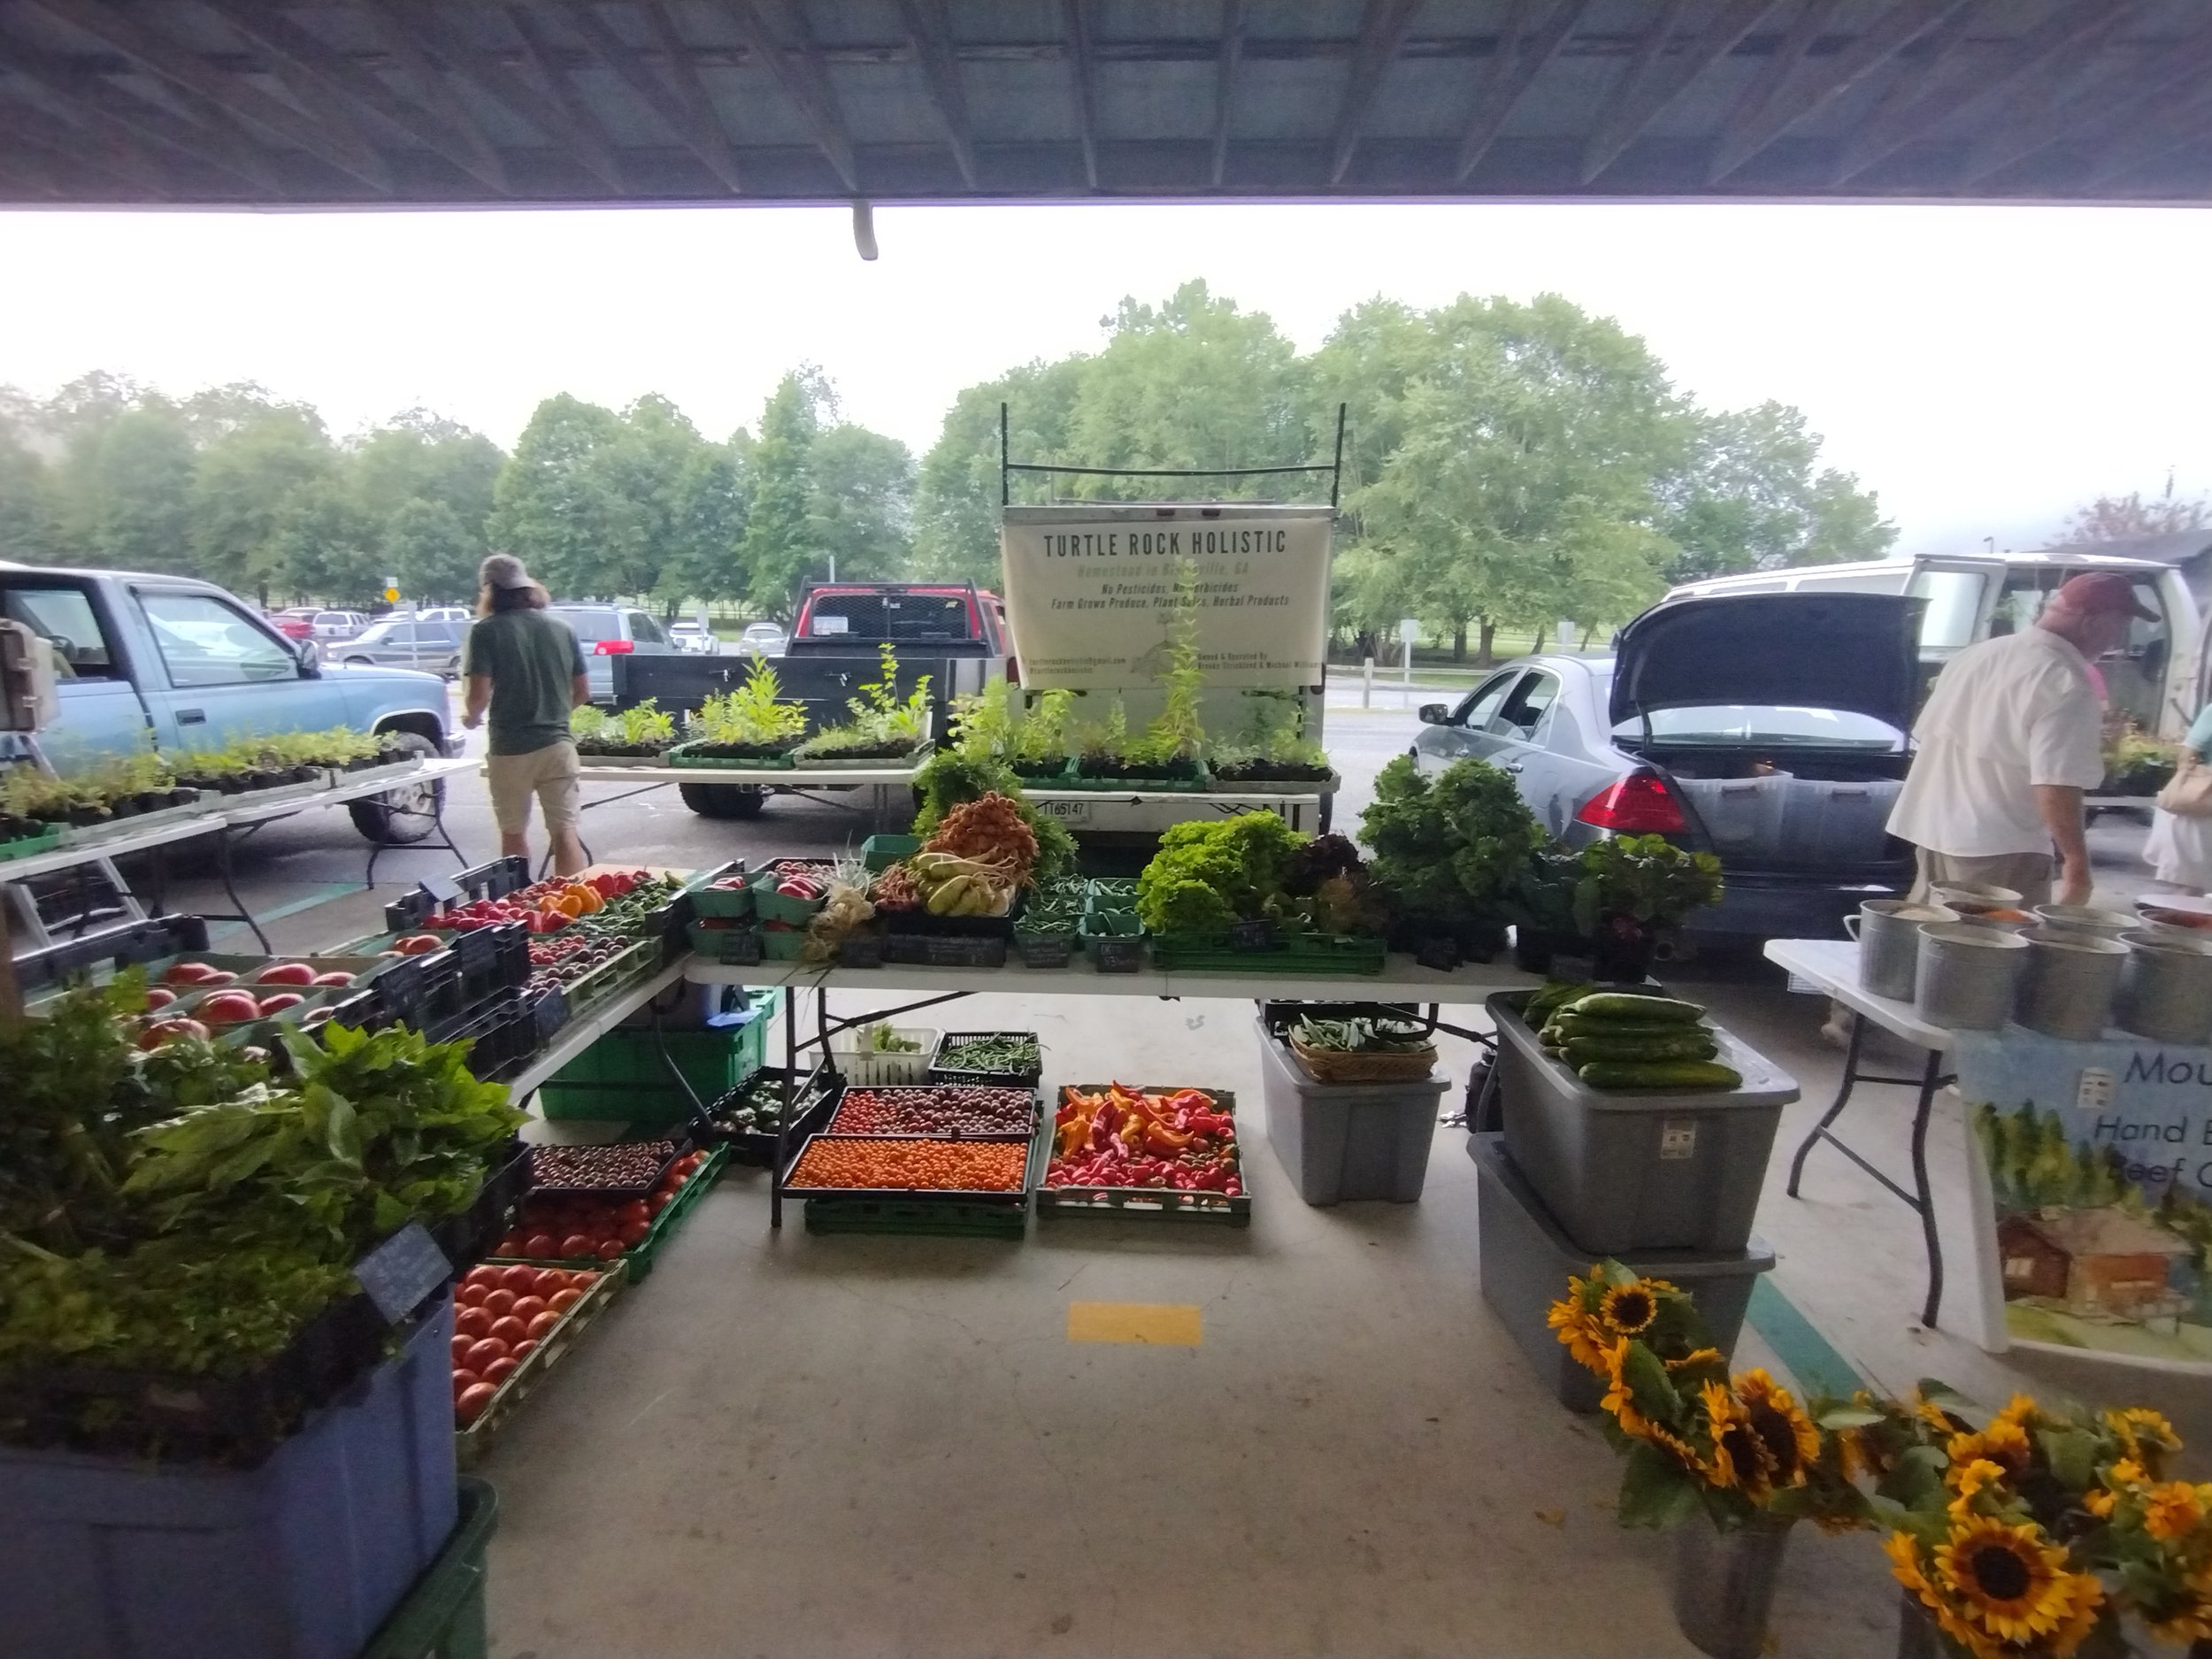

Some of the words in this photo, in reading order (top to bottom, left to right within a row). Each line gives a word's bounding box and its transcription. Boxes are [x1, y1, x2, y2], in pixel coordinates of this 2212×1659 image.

[1043, 534, 1118, 557] TURTLE
[1129, 532, 1180, 556] ROCK
[1192, 530, 1286, 554] HOLISTIC
[1077, 564, 1143, 578] Homestead
[1234, 561, 1249, 575] GA
[1101, 584, 1114, 595] No
[1117, 583, 1169, 595] Pesticides,
[1189, 581, 1239, 594] erbicides
[1051, 597, 1074, 610] Farm
[1109, 596, 1149, 609] Produce,
[1153, 595, 1179, 609] Plant
[1212, 595, 1244, 608] Herbal
[1247, 594, 1290, 607] Products
[2093, 1115, 2189, 1143] Hand
